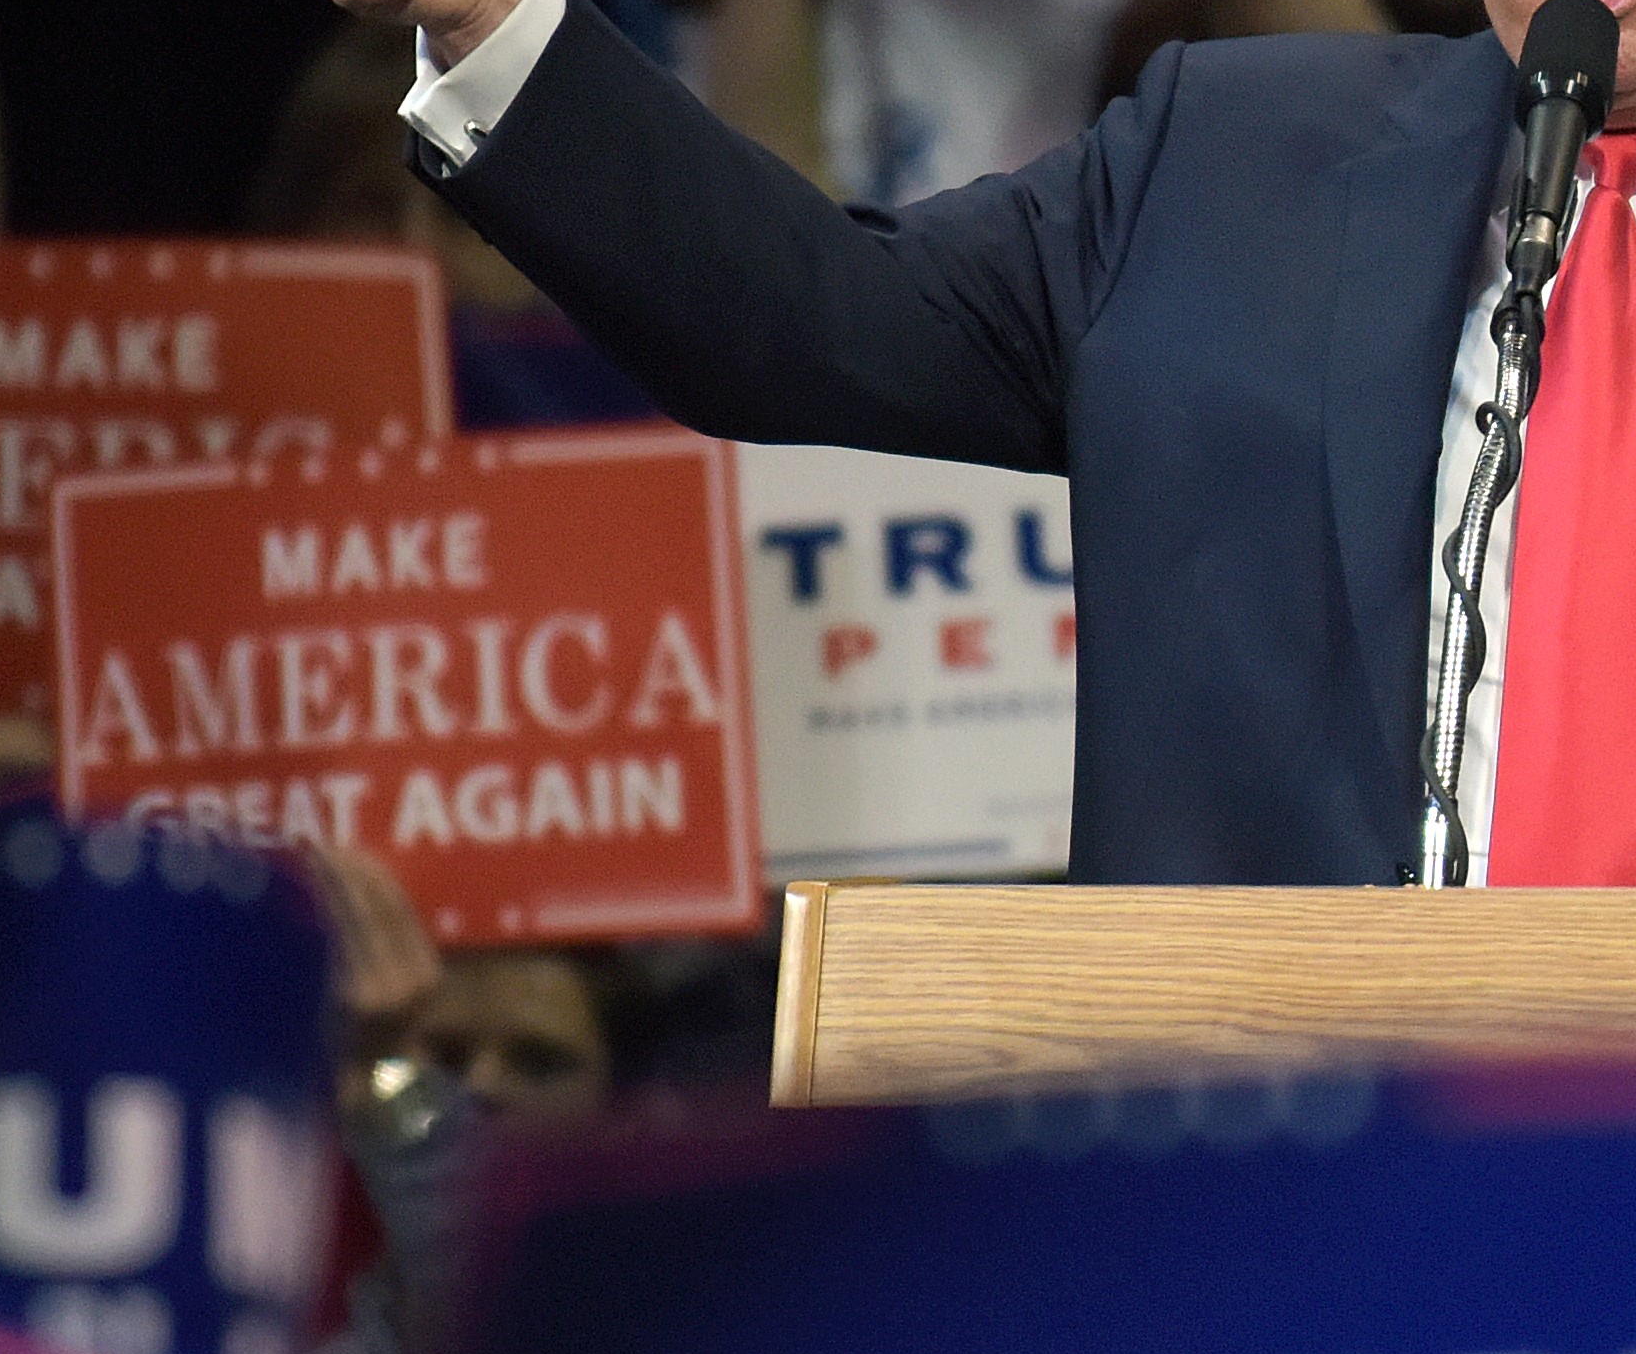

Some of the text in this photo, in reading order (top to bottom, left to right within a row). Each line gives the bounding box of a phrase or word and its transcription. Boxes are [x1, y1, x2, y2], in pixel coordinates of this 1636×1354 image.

[260, 511, 491, 598] MAKE
[75, 609, 723, 769] AMERICA
[392, 755, 687, 851] AGAIN
